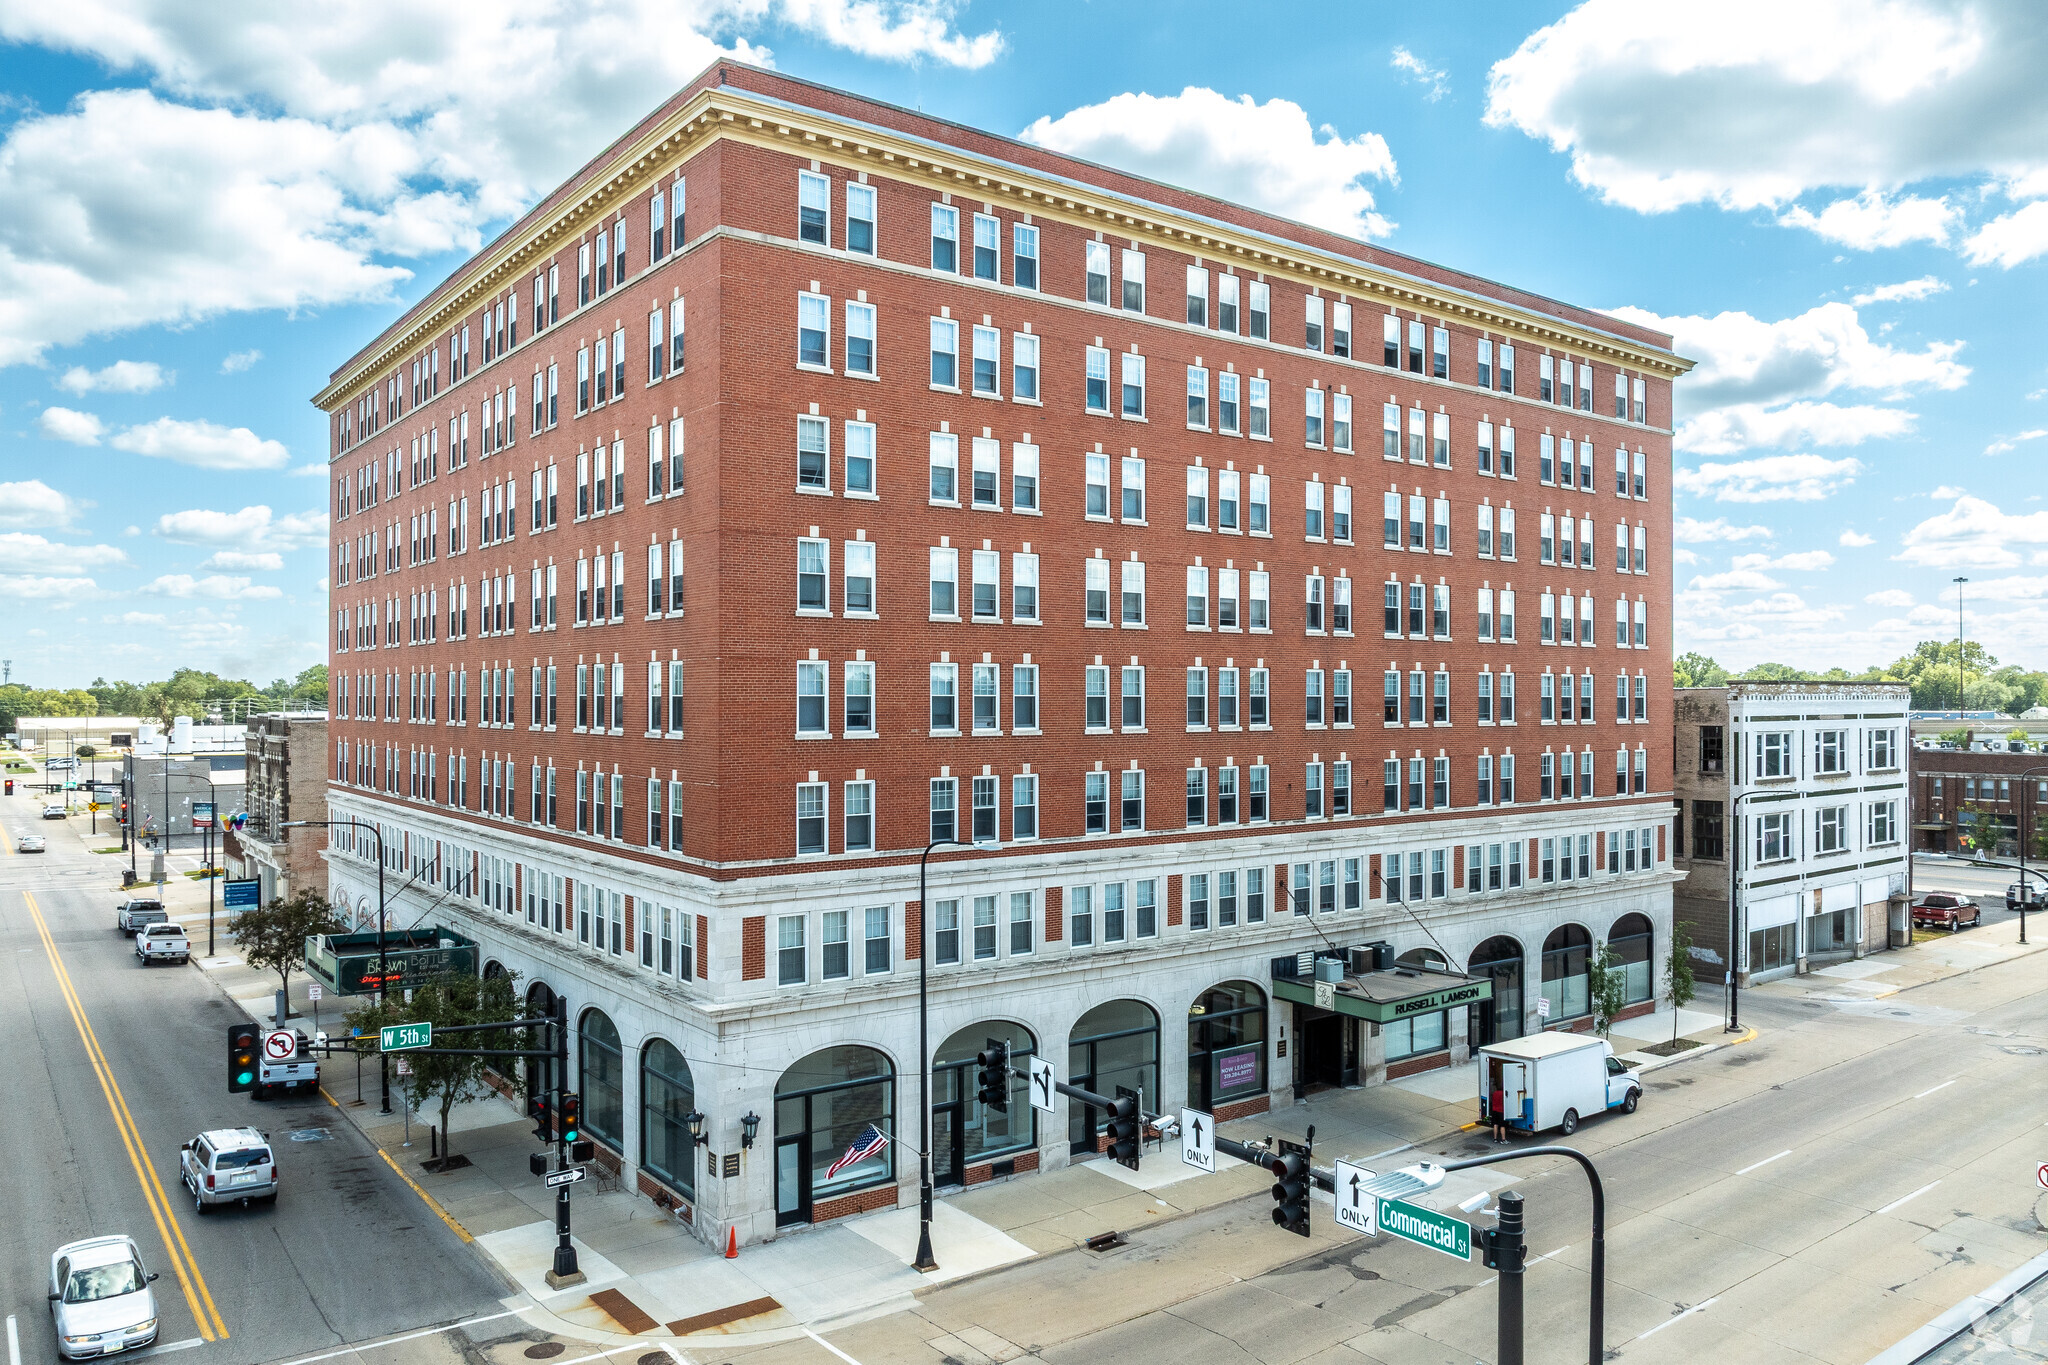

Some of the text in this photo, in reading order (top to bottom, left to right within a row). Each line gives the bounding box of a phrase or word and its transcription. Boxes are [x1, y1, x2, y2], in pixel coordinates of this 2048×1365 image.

[411, 952, 450, 966] BOTTLE
[360, 974, 401, 983] Itaan
[1395, 987, 1479, 1015] RUSSELL LAMSON
[384, 1031, 394, 1047] W
[400, 1028, 419, 1046] 5th
[1234, 1062, 1255, 1071] LEASING
[1187, 1149, 1210, 1166] ONLY
[1341, 1207, 1370, 1227] ONLY
[1381, 1201, 1467, 1254] Commercial St
